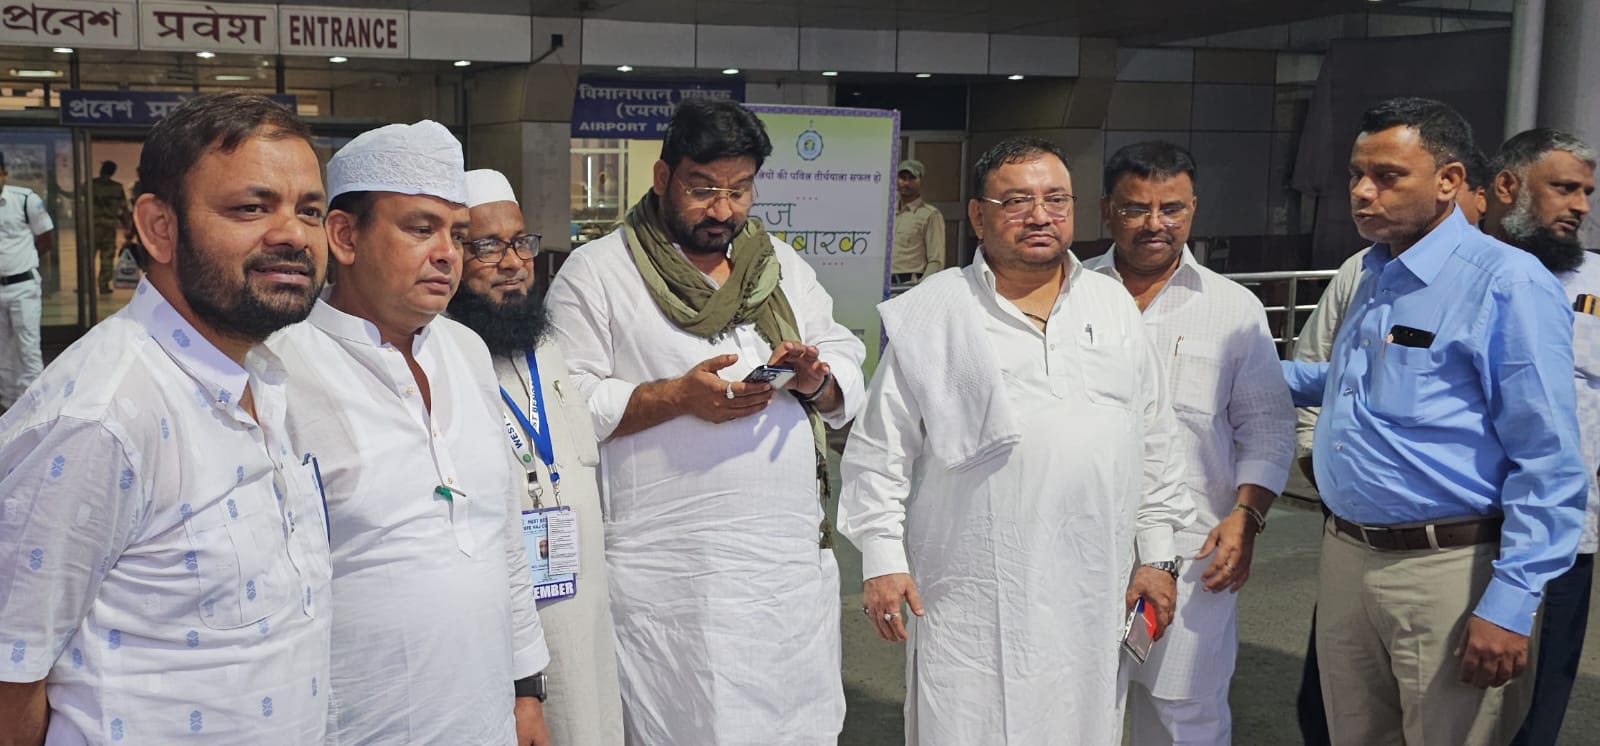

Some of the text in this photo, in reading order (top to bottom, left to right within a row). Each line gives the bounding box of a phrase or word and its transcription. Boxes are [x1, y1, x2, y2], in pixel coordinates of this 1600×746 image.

[3, 3, 121, 38] প্রবেশ
[153, 5, 267, 44] प्रवेश
[289, 15, 398, 49] ENTRANCE
[69, 97, 134, 119] প্রবেশ
[579, 122, 648, 132] AIRPORT
[776, 168, 788, 181] की
[850, 172, 872, 182] सफल
[533, 582, 575, 600] EMBER
